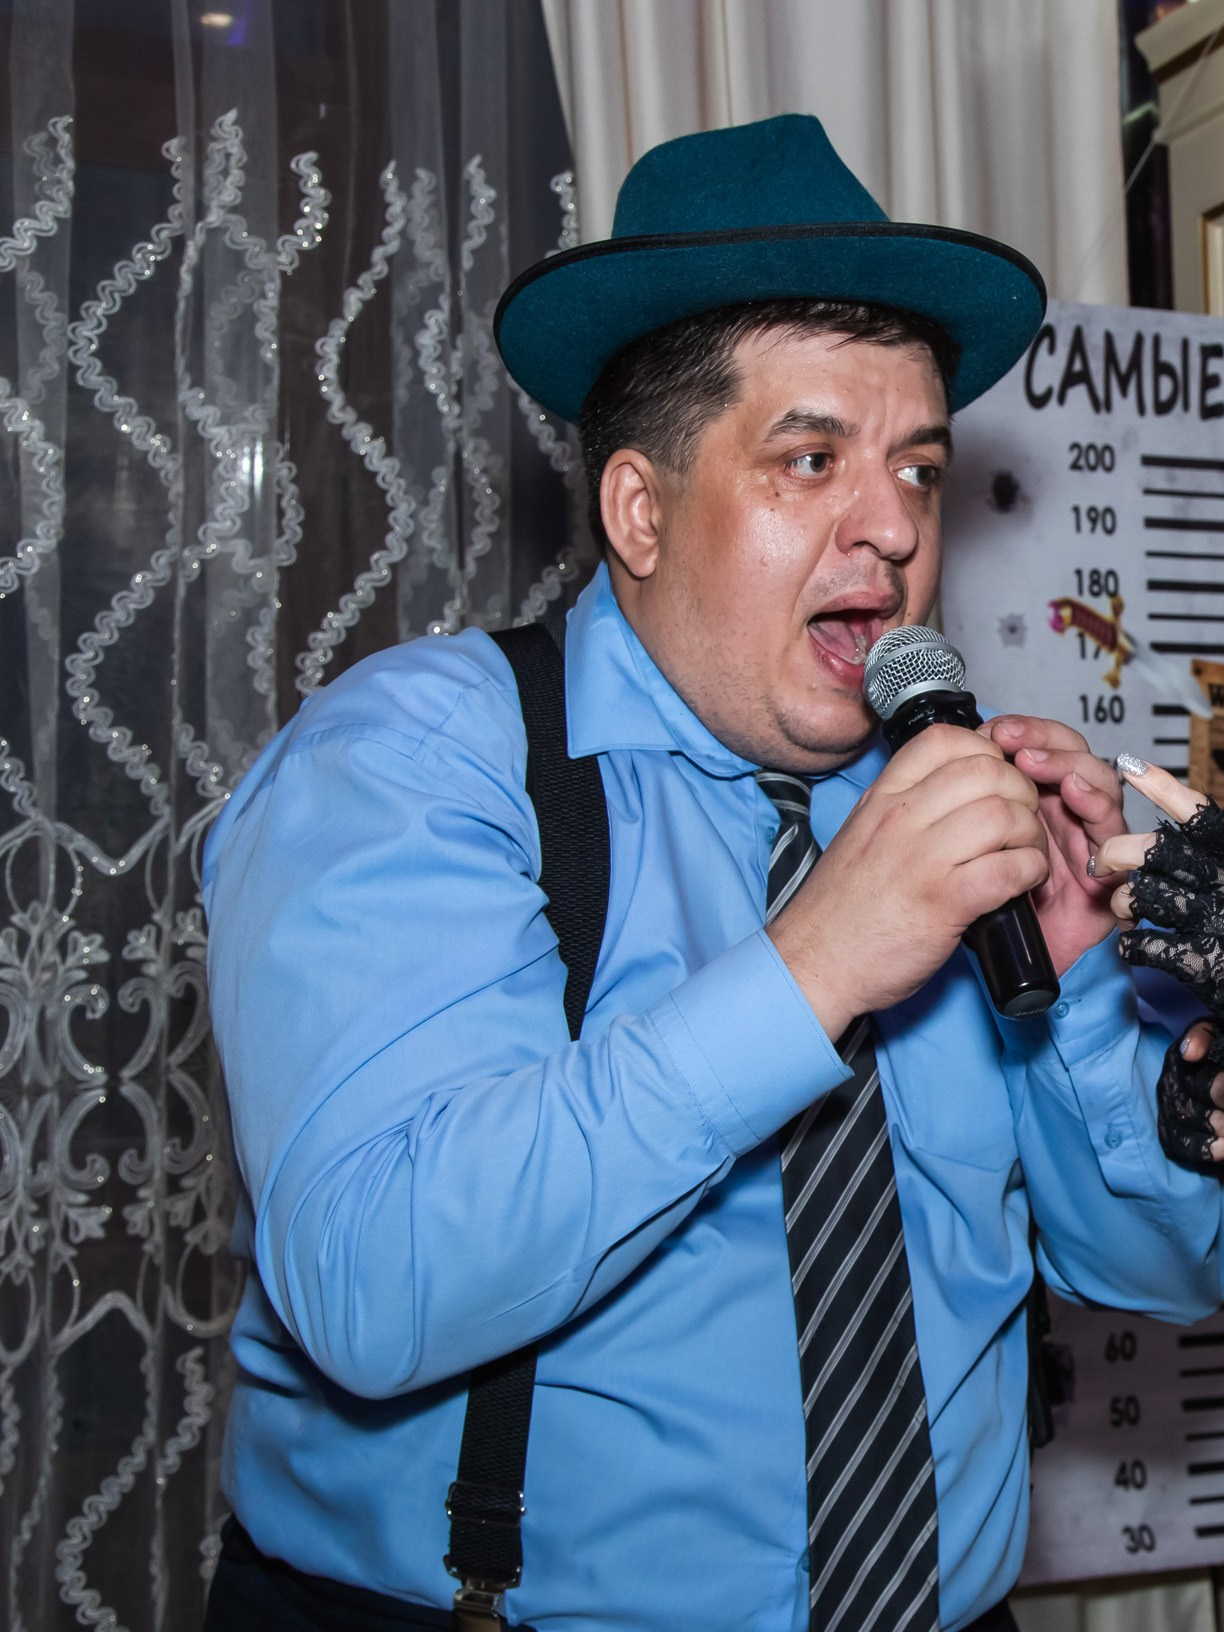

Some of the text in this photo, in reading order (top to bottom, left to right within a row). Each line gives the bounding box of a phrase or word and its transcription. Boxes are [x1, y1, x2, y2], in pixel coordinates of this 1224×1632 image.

[1069, 443, 1115, 473] 200
[1071, 506, 1117, 536] 190
[1074, 568, 1119, 598] 180
[1080, 694, 1125, 724] 160
[1105, 1331, 1137, 1362] 60
[1109, 1396, 1140, 1427] 50
[1114, 1460, 1147, 1490] 40
[1121, 1525, 1155, 1554] 30
